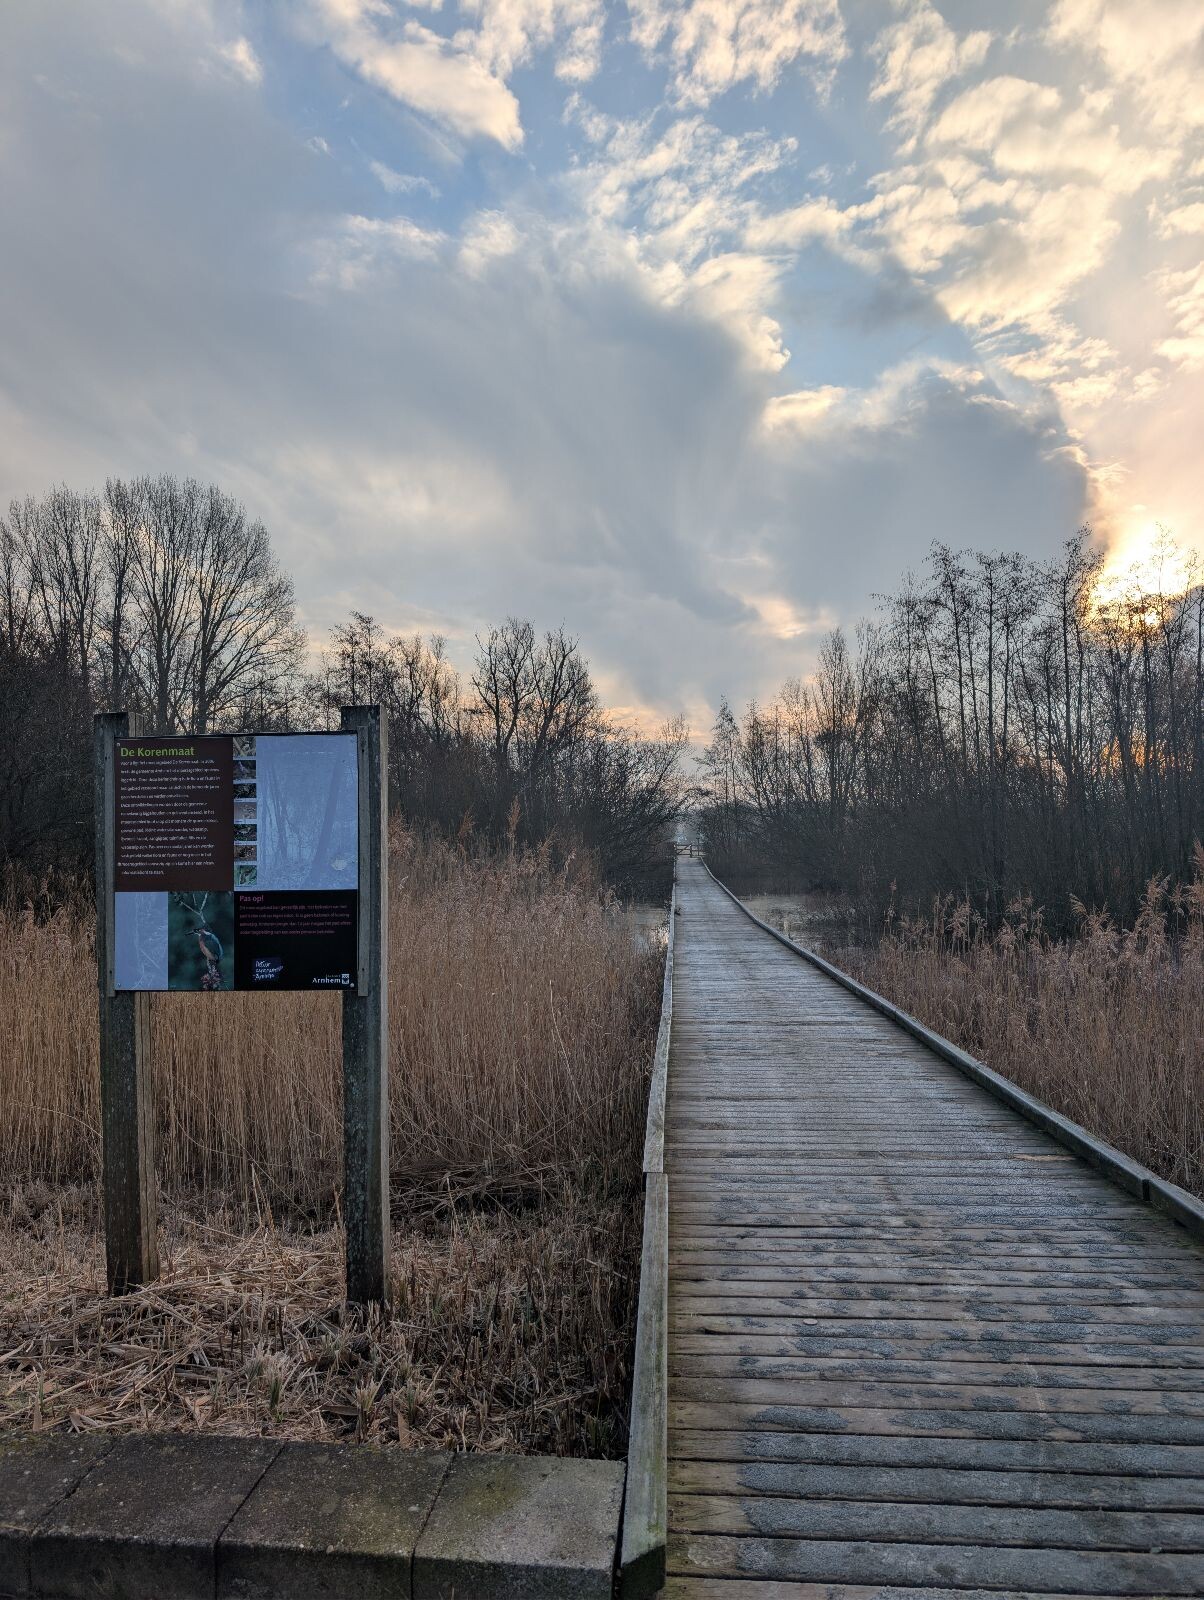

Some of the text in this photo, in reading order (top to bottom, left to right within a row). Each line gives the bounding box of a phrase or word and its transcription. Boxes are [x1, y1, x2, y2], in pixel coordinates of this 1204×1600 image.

[121, 747, 195, 757] De Korenmaat
[252, 894, 264, 904] op!
